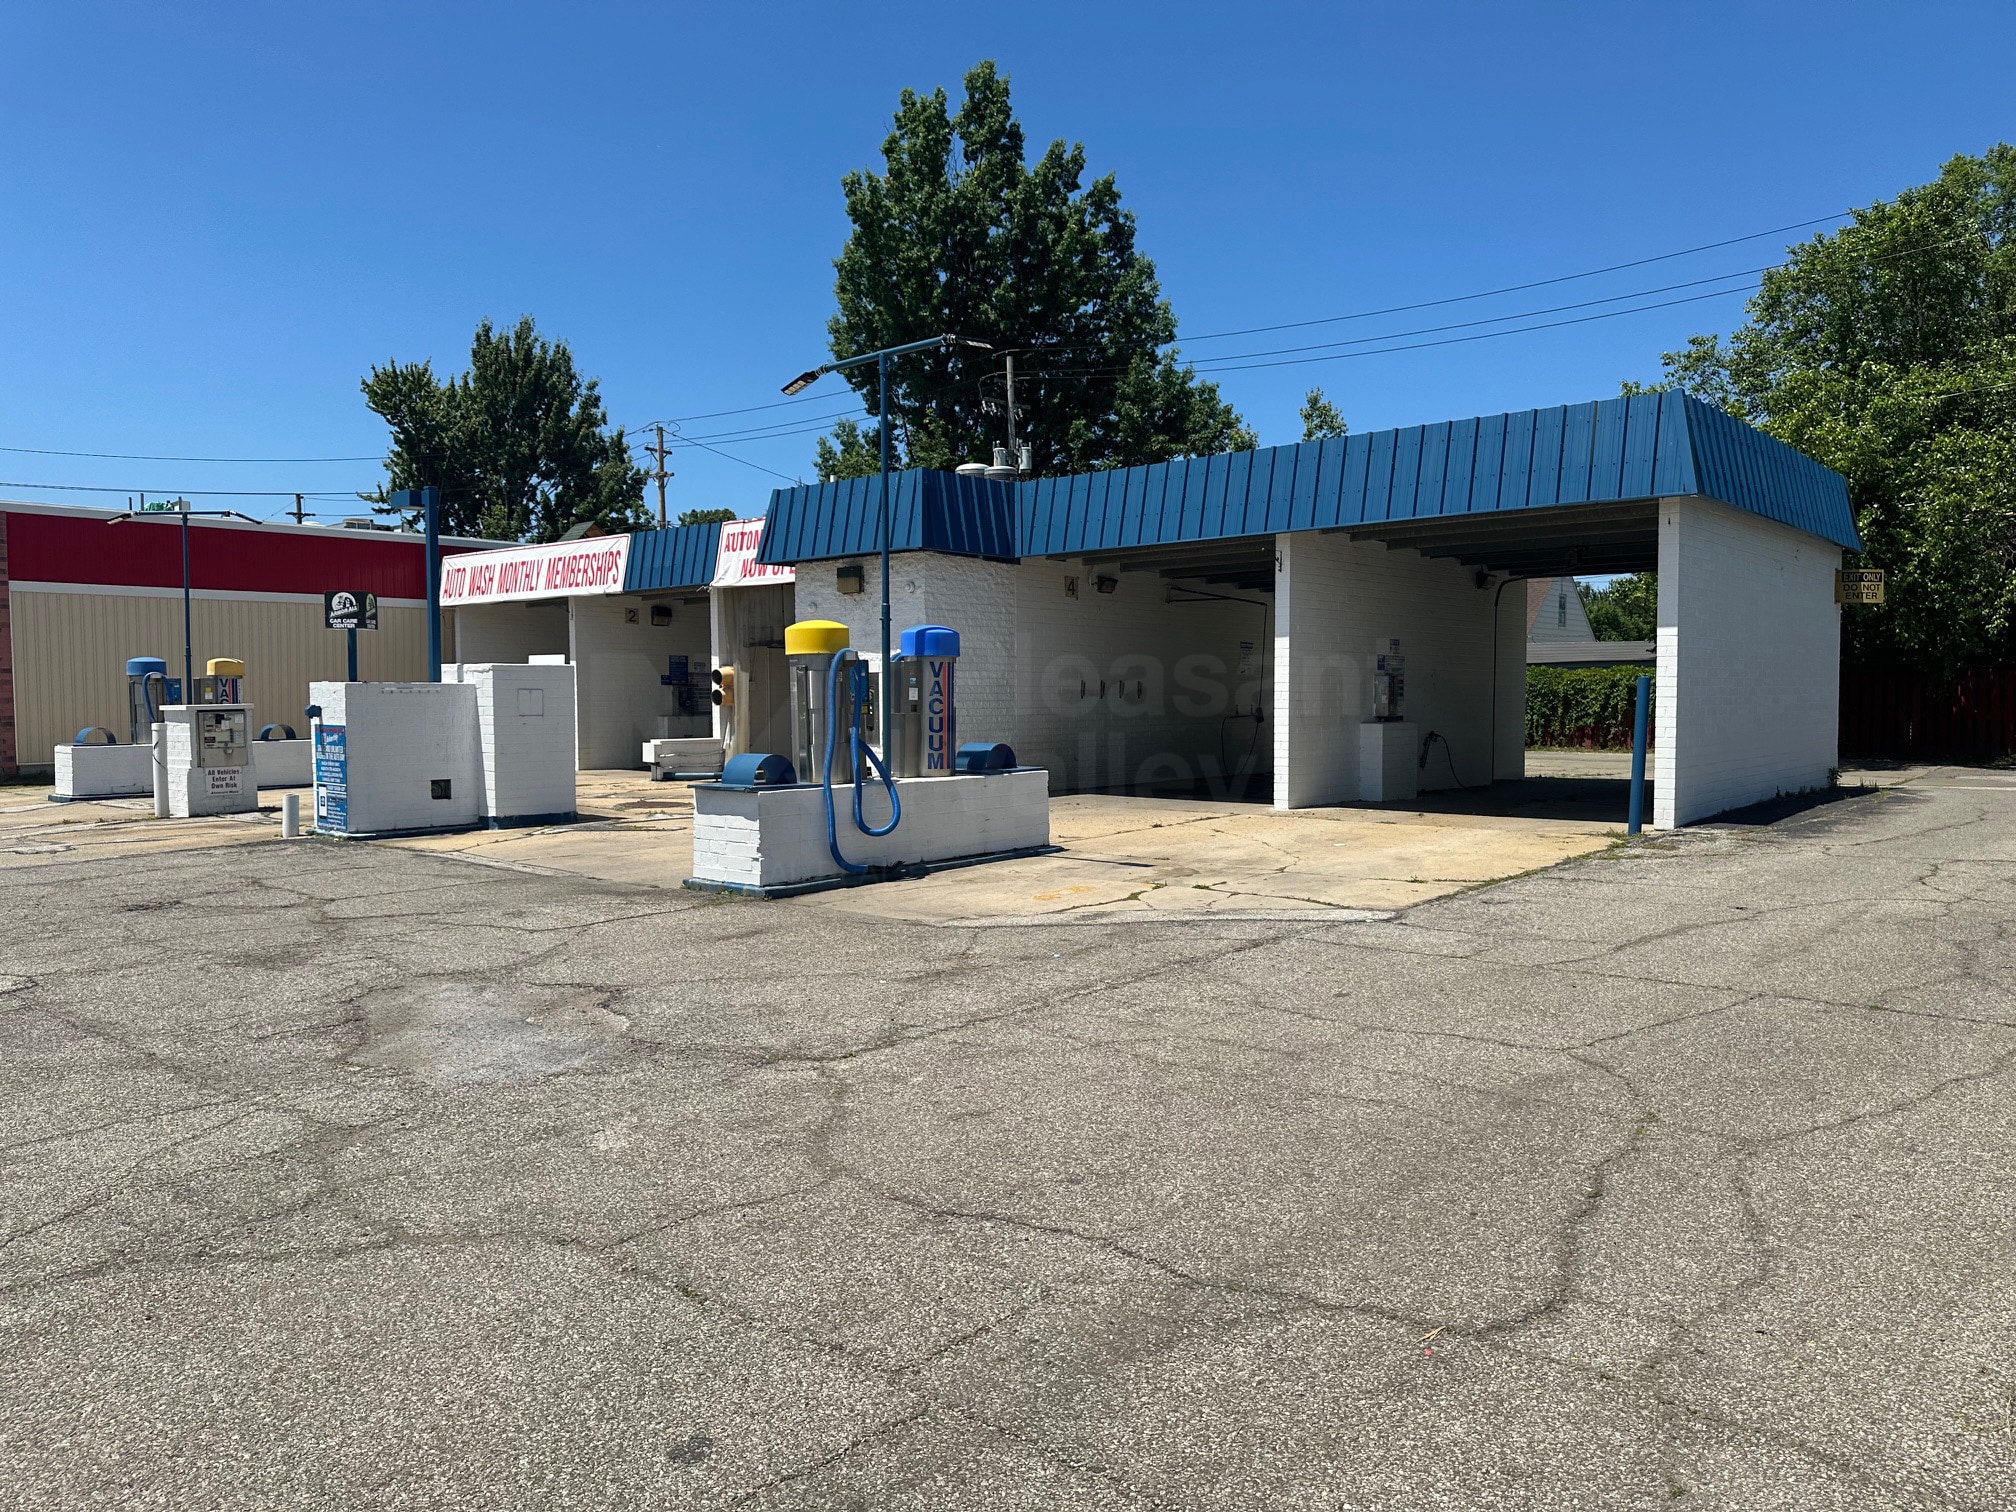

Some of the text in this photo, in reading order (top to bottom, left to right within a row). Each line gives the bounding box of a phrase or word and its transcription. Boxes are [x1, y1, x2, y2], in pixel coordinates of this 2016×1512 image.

[443, 549, 621, 599] AUTO WASH MONTHLY MEMBERSHIPS
[1844, 572, 1880, 582] EXIT ONLY
[1067, 579, 1076, 595] 4
[1844, 584, 1881, 592] DO NOT
[1846, 592, 1878, 600] ENTER
[628, 610, 636, 623] 2
[927, 661, 944, 769] VACUUM
